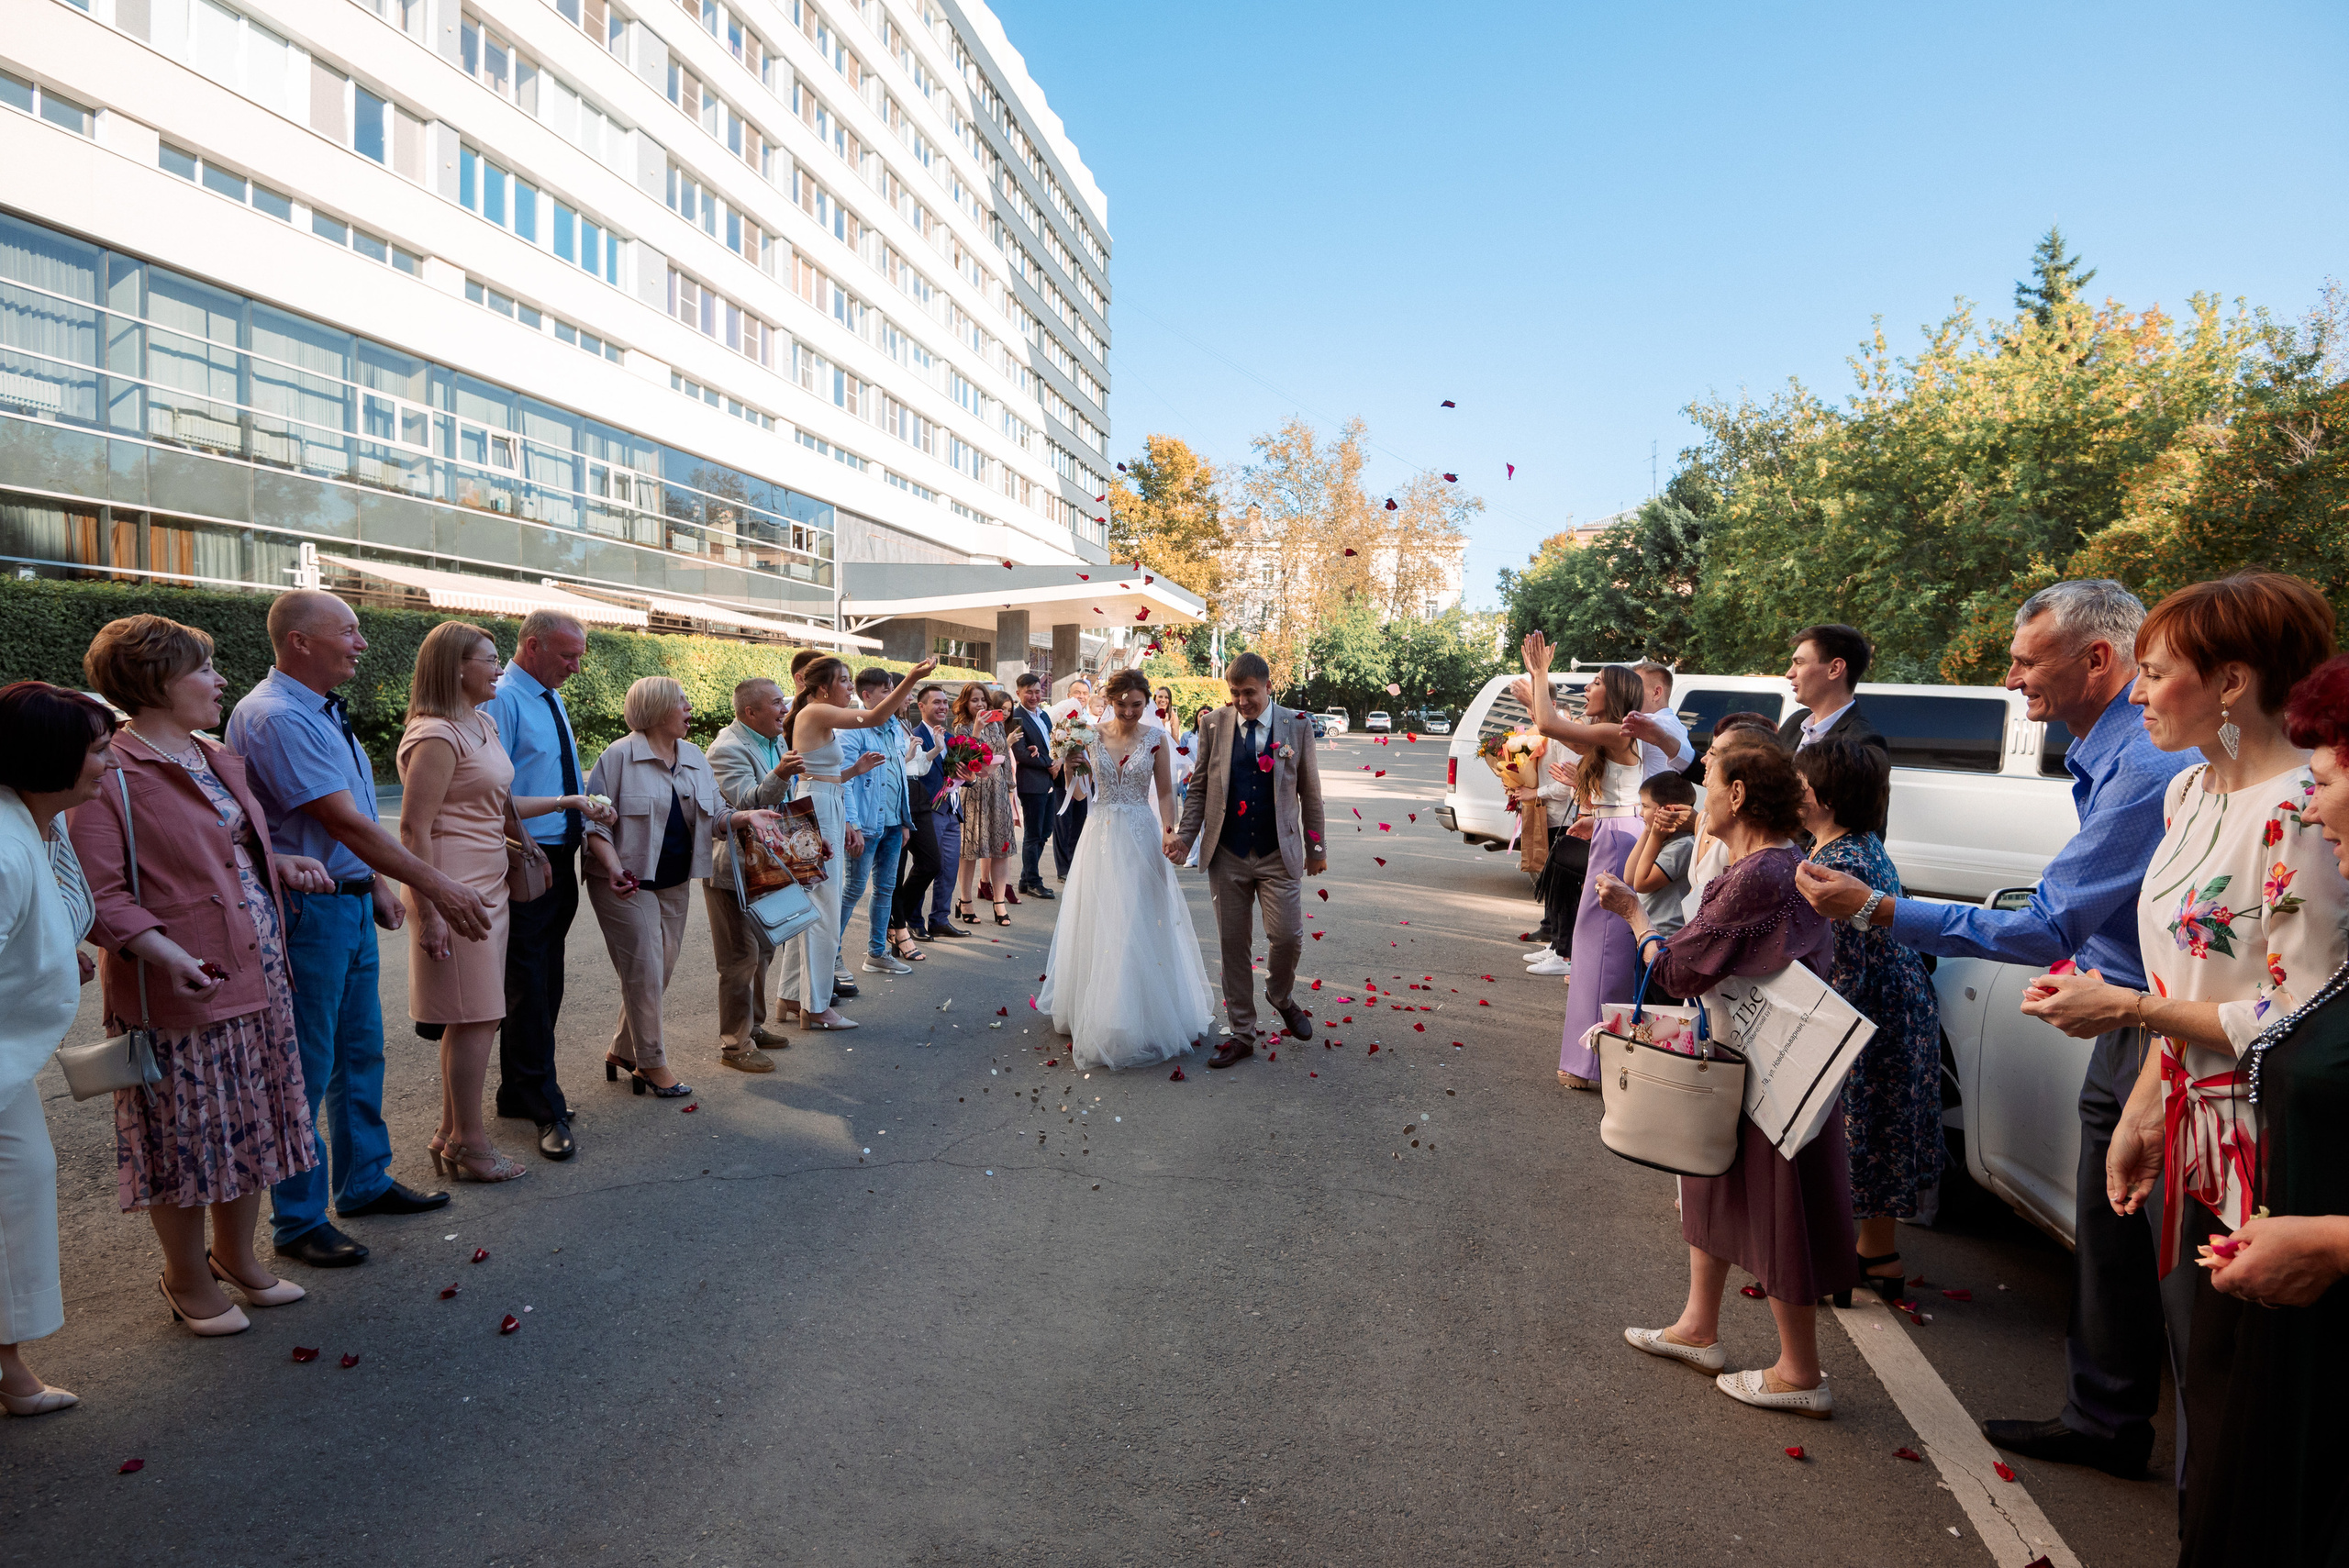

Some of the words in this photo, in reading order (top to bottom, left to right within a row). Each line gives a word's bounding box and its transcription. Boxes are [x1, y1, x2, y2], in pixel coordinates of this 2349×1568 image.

[1744, 1015, 1766, 1047] НОМИЧЕСКИЙ
[1762, 1077, 1771, 1087] та,
[1768, 1069, 1776, 1079] ул.
[1772, 1022, 1806, 1069] Новобульварная,
